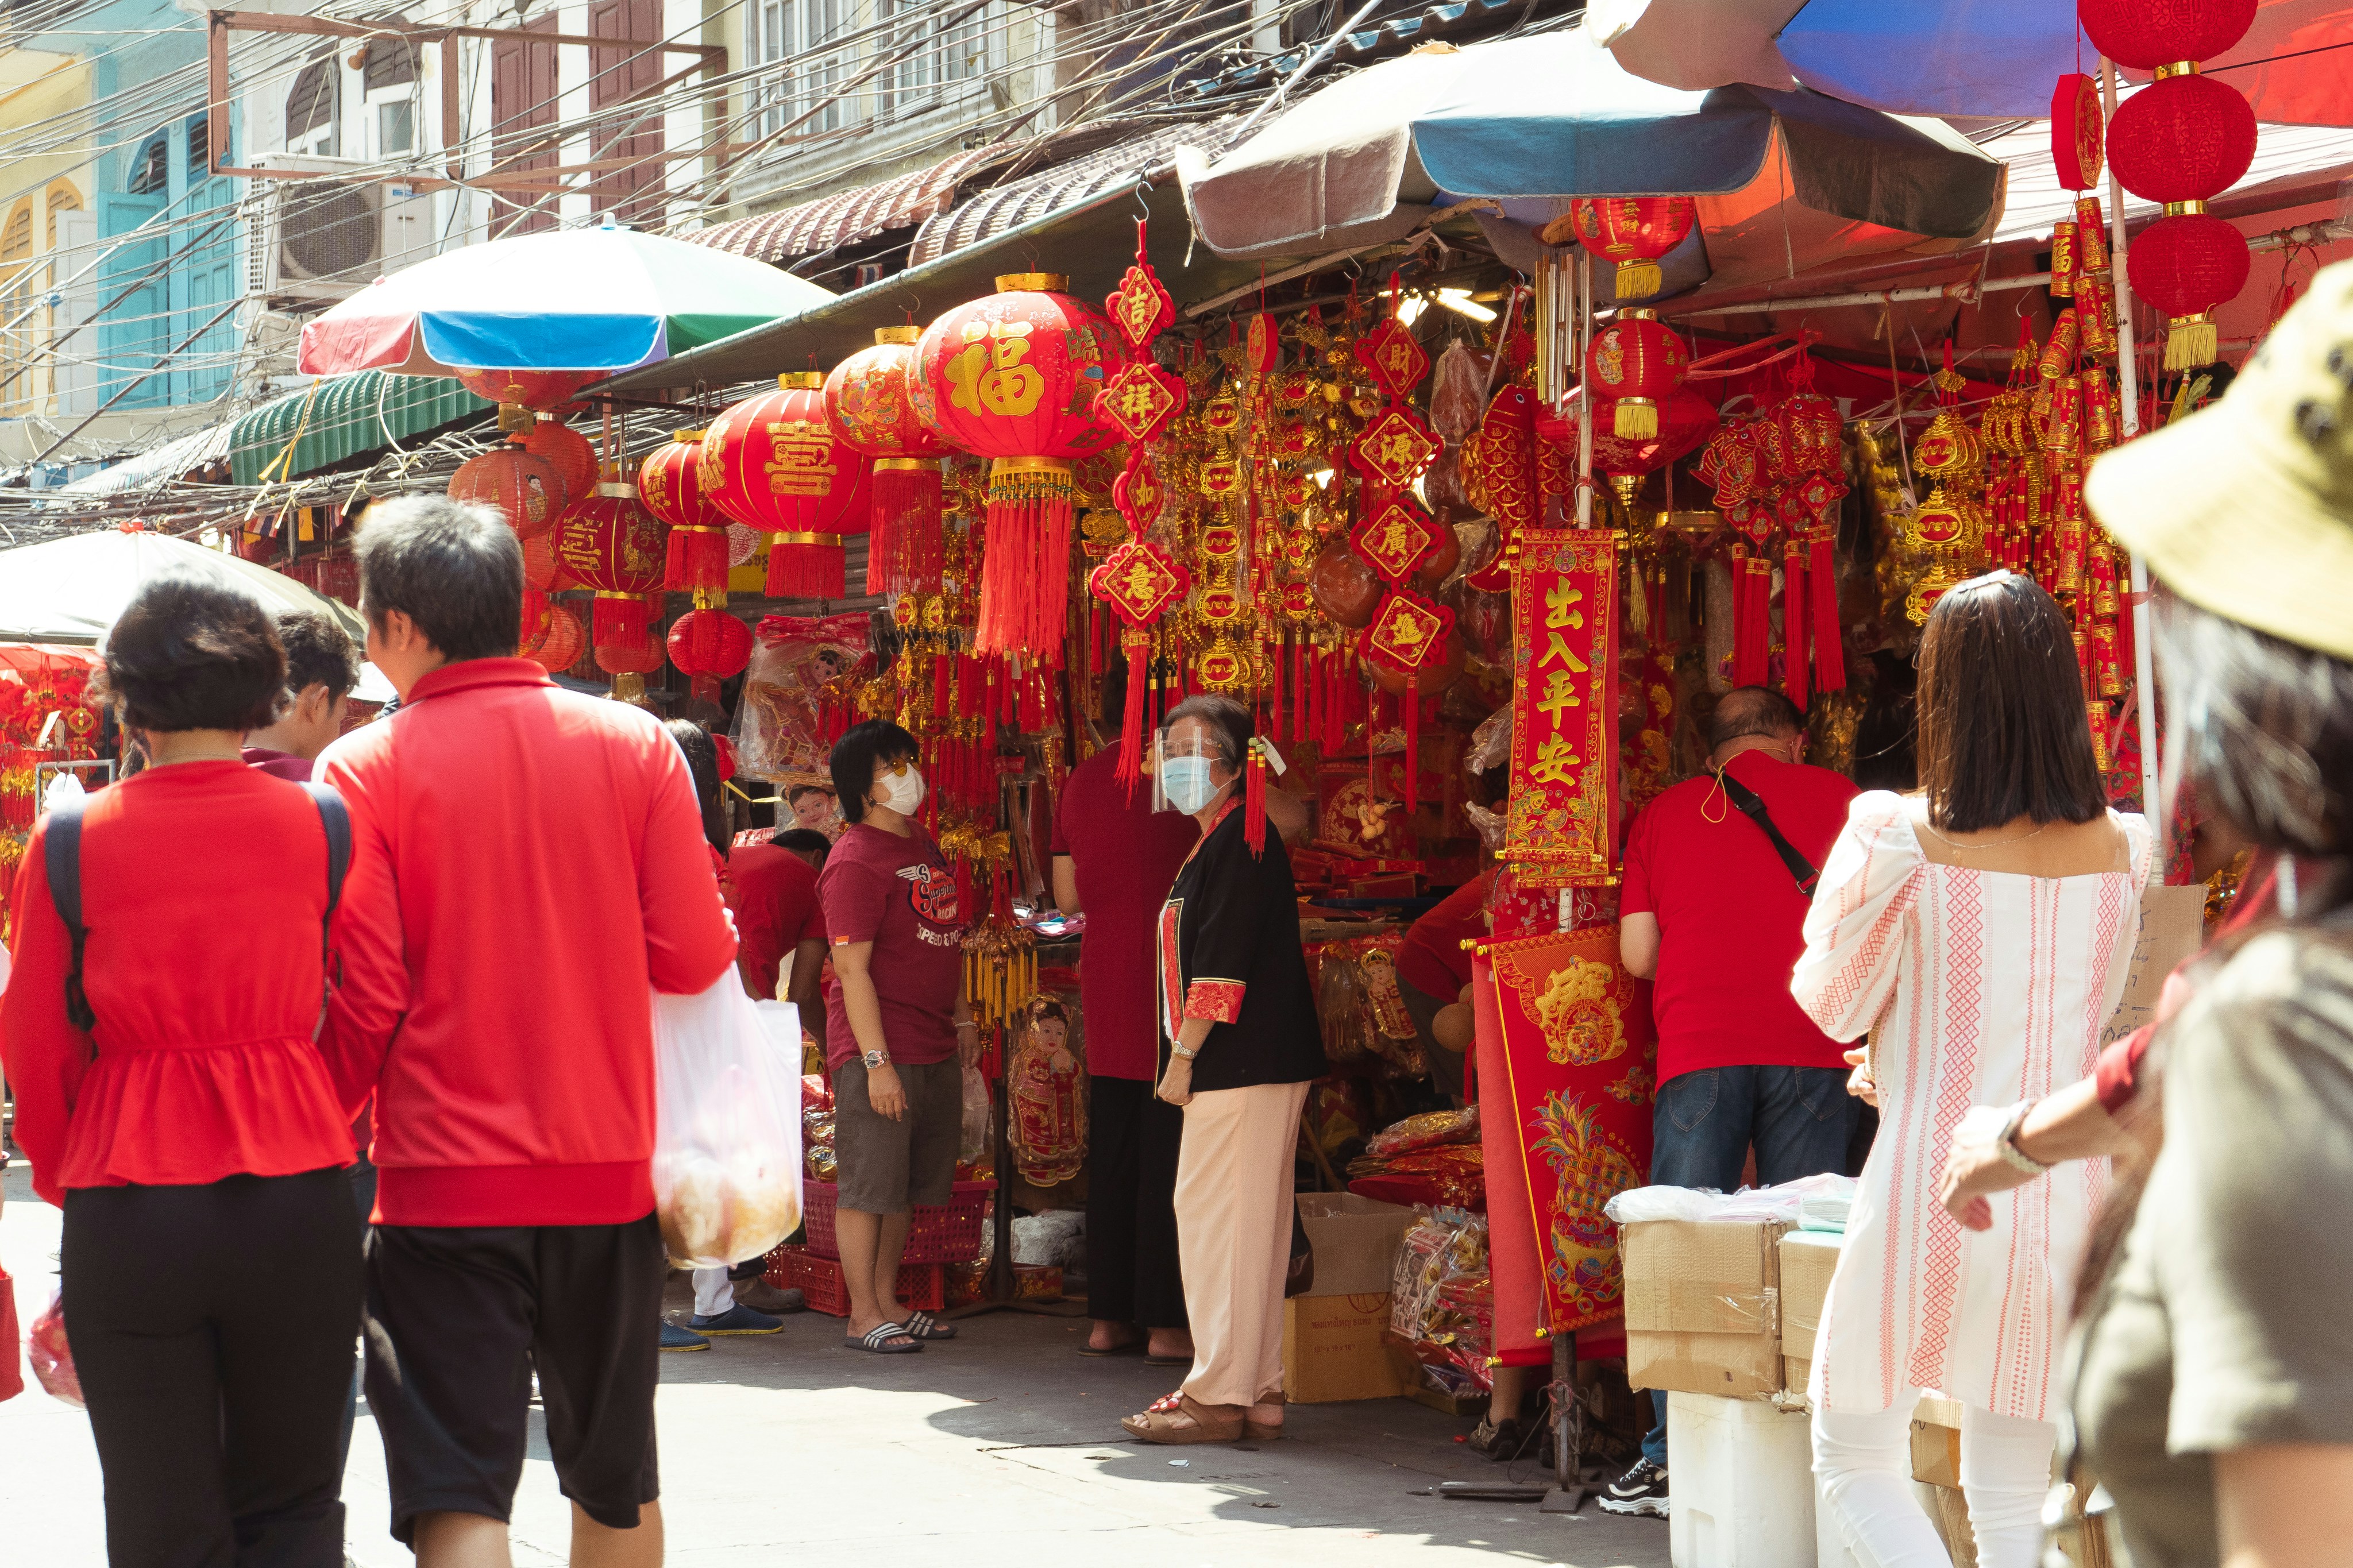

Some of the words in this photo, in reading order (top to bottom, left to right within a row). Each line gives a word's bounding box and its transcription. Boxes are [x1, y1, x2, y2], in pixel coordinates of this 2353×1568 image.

[1128, 287, 1148, 326] 吉
[1388, 343, 1411, 375] 財
[943, 320, 1044, 418] 福
[1121, 383, 1154, 418] 祥
[1491, 427, 1502, 437] 福
[1380, 431, 1414, 465] 源
[1484, 442, 1492, 450] 福
[1507, 440, 1517, 450] 福
[1492, 452, 1503, 462] 福
[1550, 456, 1559, 466] 福
[1505, 465, 1514, 475] 福
[1537, 469, 1547, 479] 福
[1489, 477, 1499, 488] 福
[1517, 479, 1526, 489] 福
[1553, 482, 1563, 491] 福
[1136, 474, 1154, 507] 如
[1502, 492, 1512, 502] 福
[1517, 505, 1526, 515] 福
[1378, 520, 1408, 556] 廣
[1122, 562, 1157, 600] 意
[1390, 613, 1425, 645] 進
[1529, 576, 1588, 787] 出入平安
[919, 866, 928, 881] S
[950, 929, 960, 945] PO
